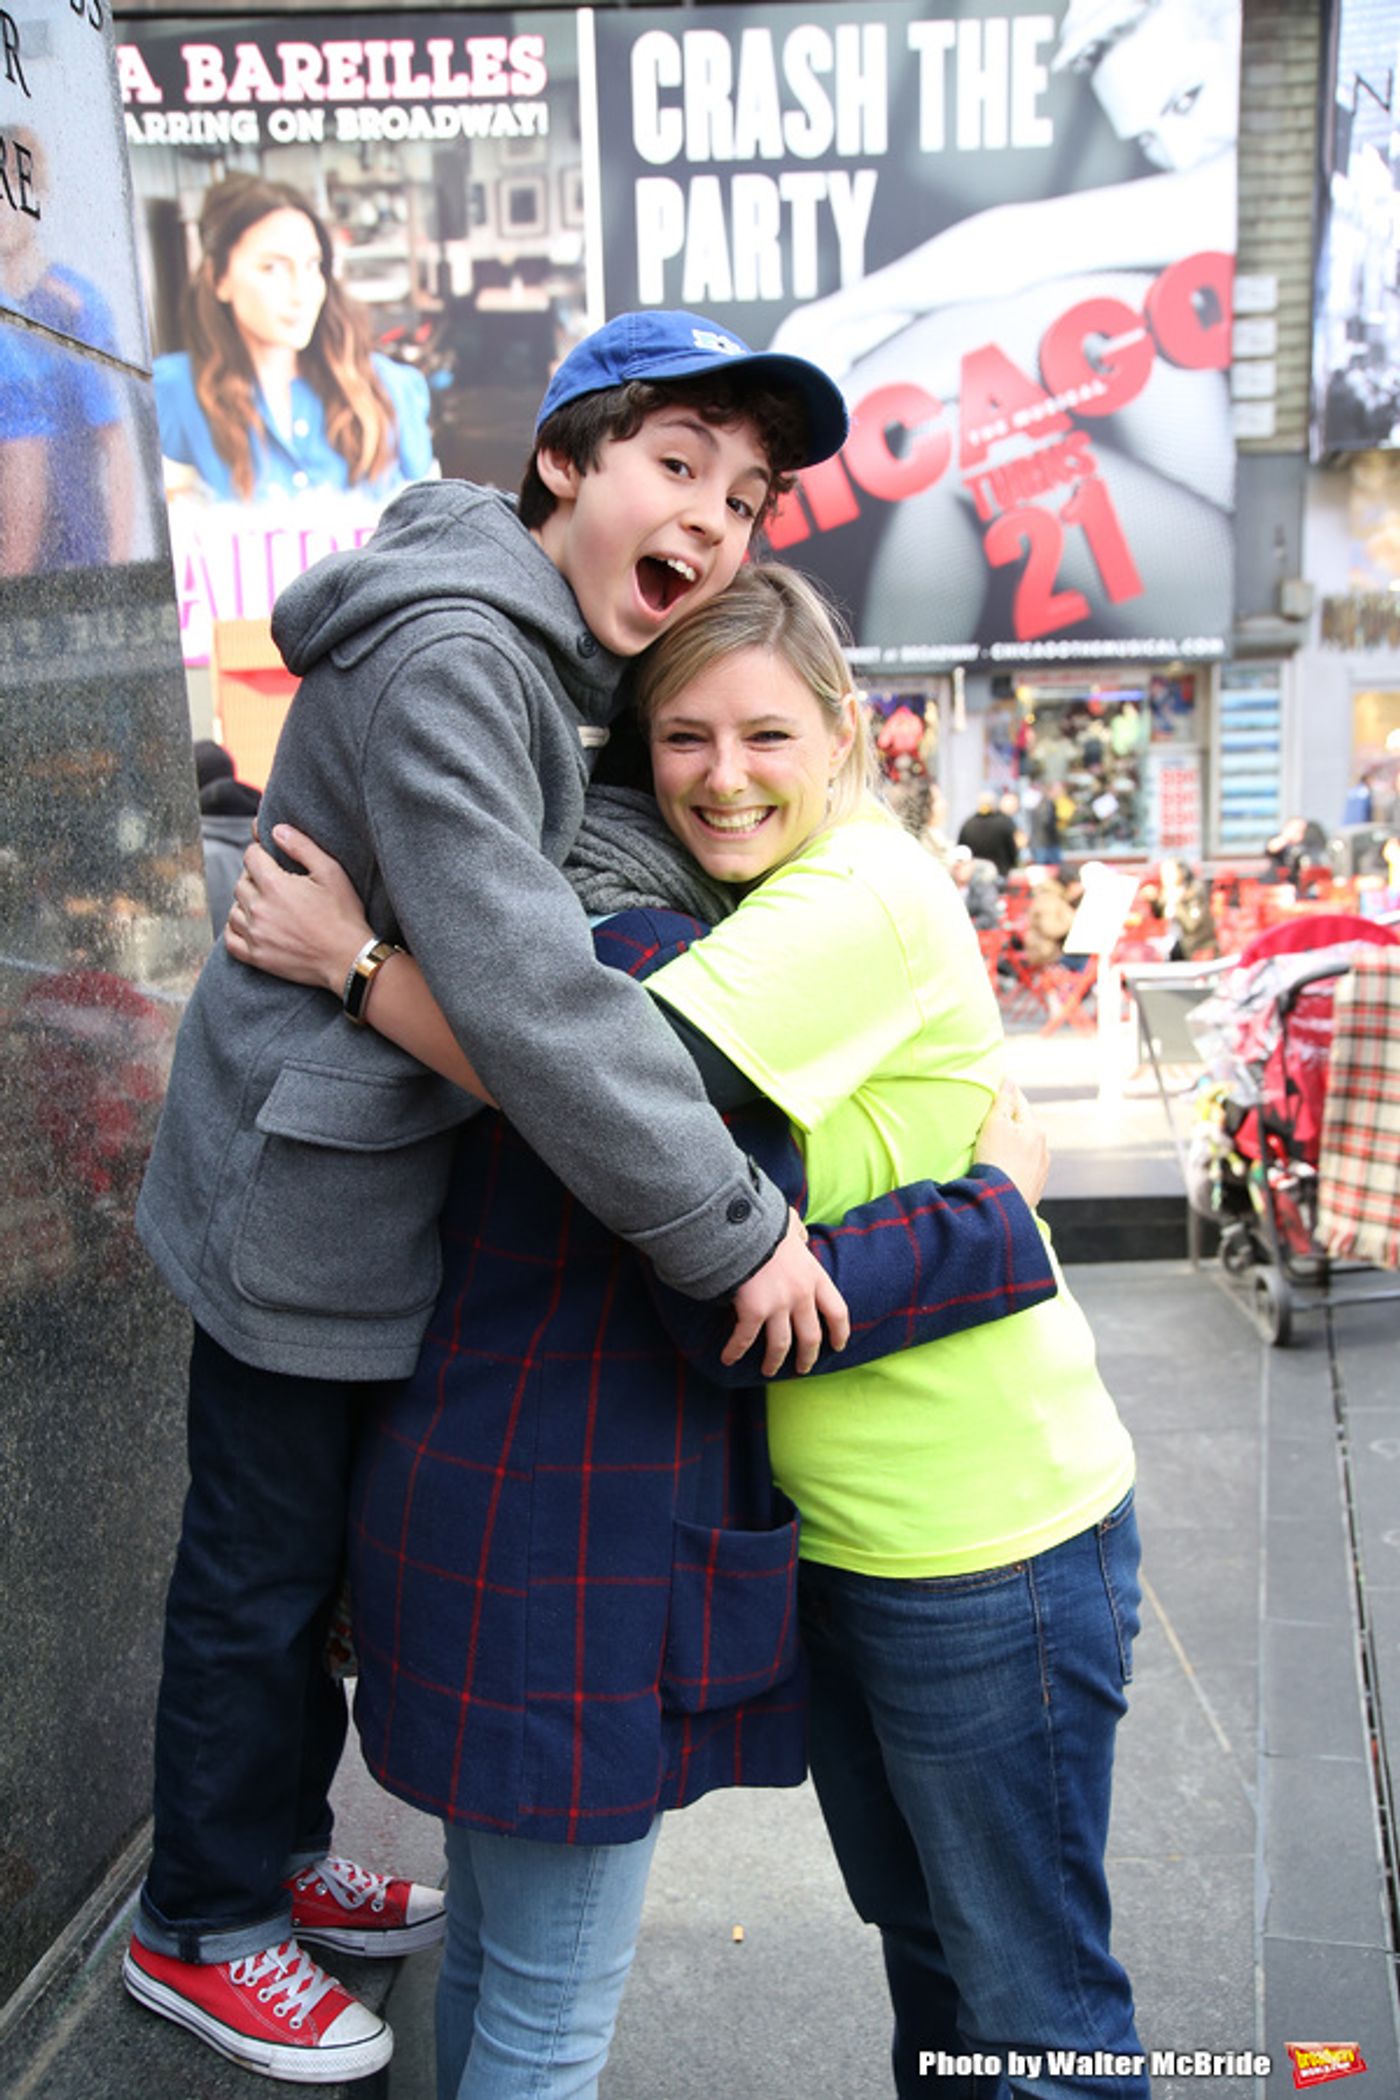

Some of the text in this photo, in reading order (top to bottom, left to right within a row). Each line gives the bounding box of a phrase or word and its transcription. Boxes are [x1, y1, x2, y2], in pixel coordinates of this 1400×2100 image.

[182, 35, 548, 102] BAREILLES
[268, 108, 325, 143] ON
[337, 102, 549, 141] BROADWAY!
[630, 15, 1054, 165] CRASH THE
[635, 169, 878, 304] PARTY
[983, 478, 1145, 643] 21
